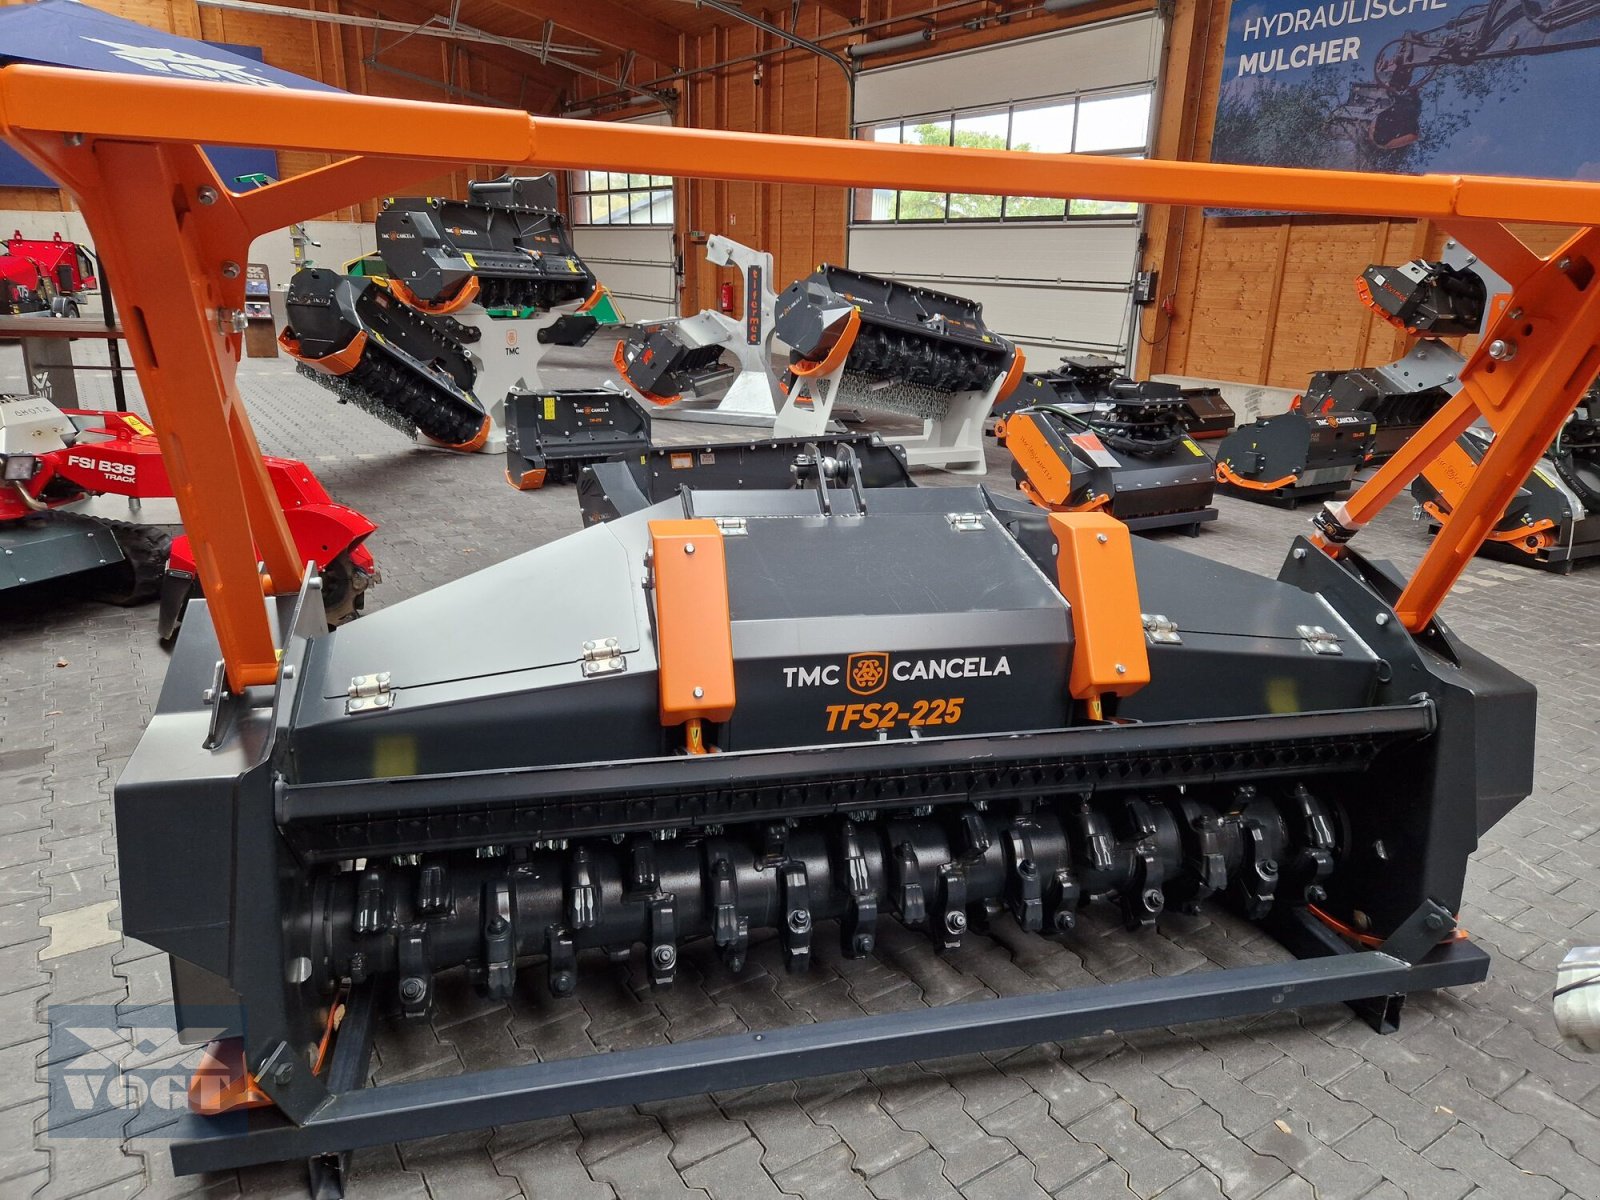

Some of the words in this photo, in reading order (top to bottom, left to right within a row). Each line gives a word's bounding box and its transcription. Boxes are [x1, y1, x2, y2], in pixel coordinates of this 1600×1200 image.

[1243, 0, 1447, 42] HYDRAULISCHE
[1237, 36, 1361, 77] MULCHER
[505, 347, 520, 356] TMC
[68, 455, 96, 470] FSI
[98, 460, 136, 476] B38
[104, 472, 137, 484] TRACK
[783, 665, 840, 688] TMC
[892, 656, 1011, 682] CANCELA
[825, 698, 965, 732] TFS2-225
